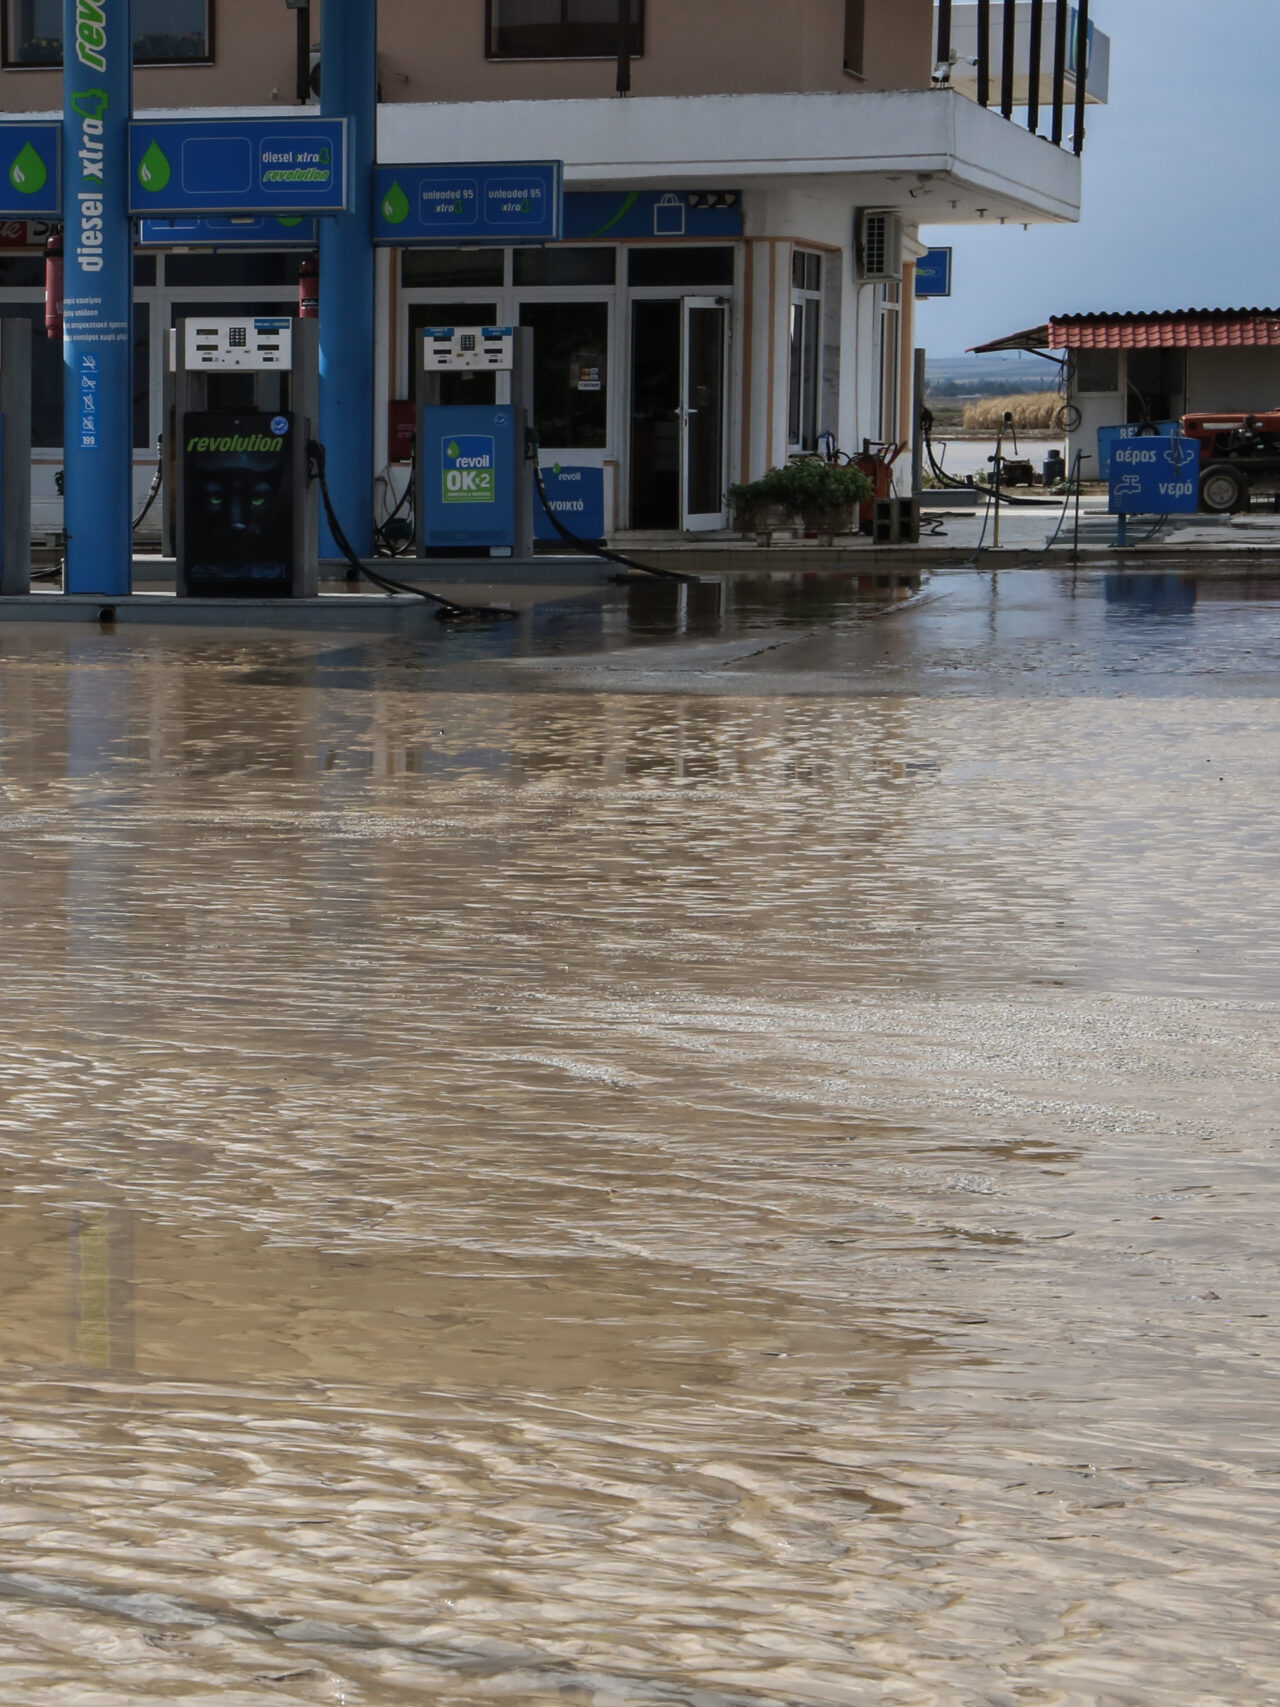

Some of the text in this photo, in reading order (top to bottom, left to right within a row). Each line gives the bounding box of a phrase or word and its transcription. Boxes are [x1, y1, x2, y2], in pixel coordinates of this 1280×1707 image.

[75, 0, 107, 72] rev
[262, 151, 293, 163] diesel
[262, 167, 330, 182] revolution
[422, 189, 475, 200] unleaded 95
[488, 187, 542, 199] unleaded 95
[76, 193, 104, 272] diesel
[186, 434, 284, 452] revolution
[456, 454, 490, 468] revoil
[1115, 446, 1157, 466] αέρας
[558, 472, 582, 481] revoil
[1158, 479, 1193, 498] νερό
[544, 498, 585, 511] νοικτό
